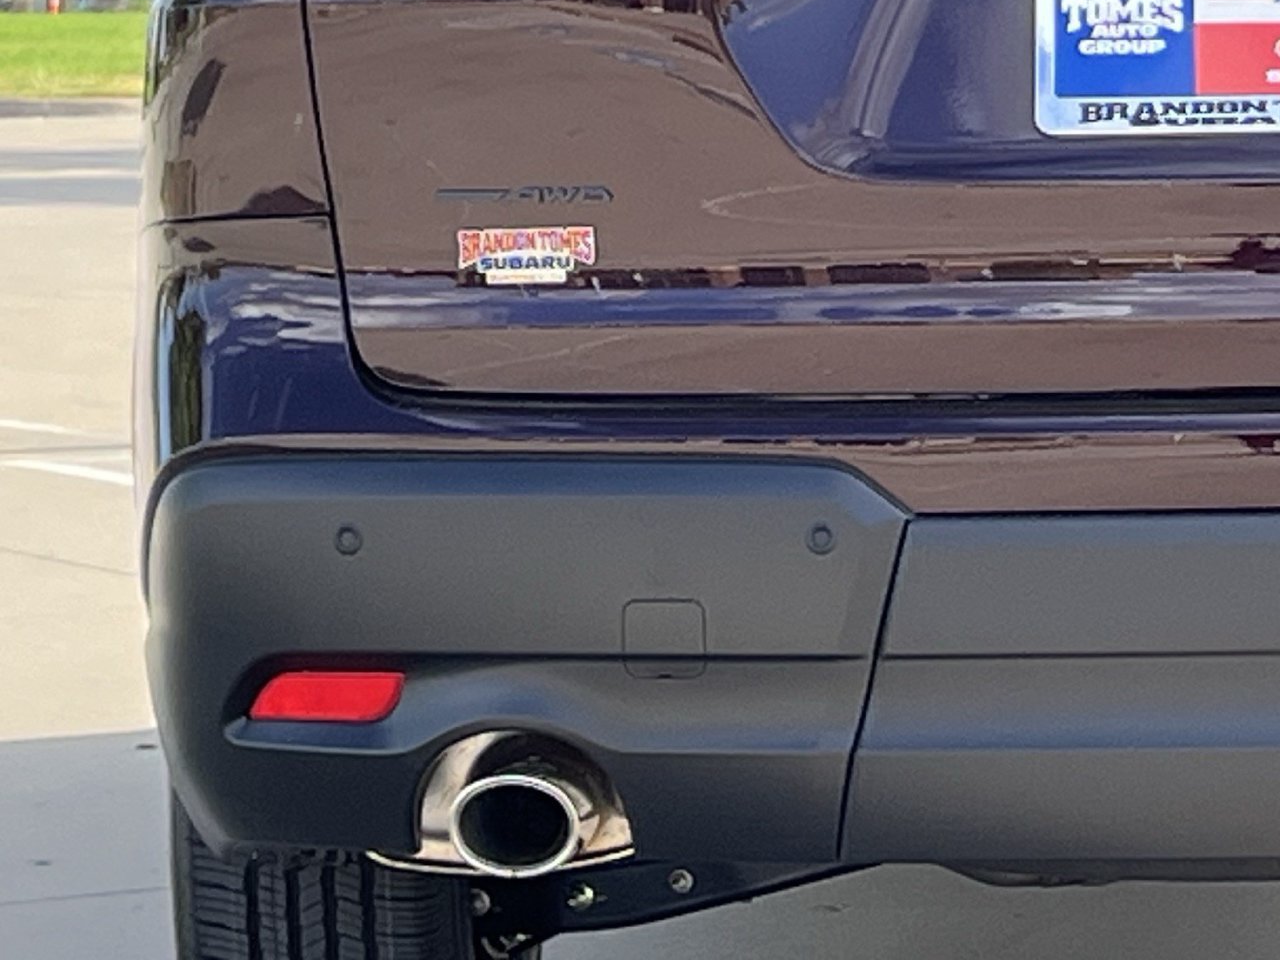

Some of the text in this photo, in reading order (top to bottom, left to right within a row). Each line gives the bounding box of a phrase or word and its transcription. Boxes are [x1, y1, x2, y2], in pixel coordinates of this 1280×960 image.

[1091, 24, 1158, 38] AUTO
[1078, 39, 1167, 55] GROUP
[1079, 100, 1268, 124] BRANDON
[461, 229, 592, 263] BRANDON TOMES
[480, 256, 570, 269] SUBARU
